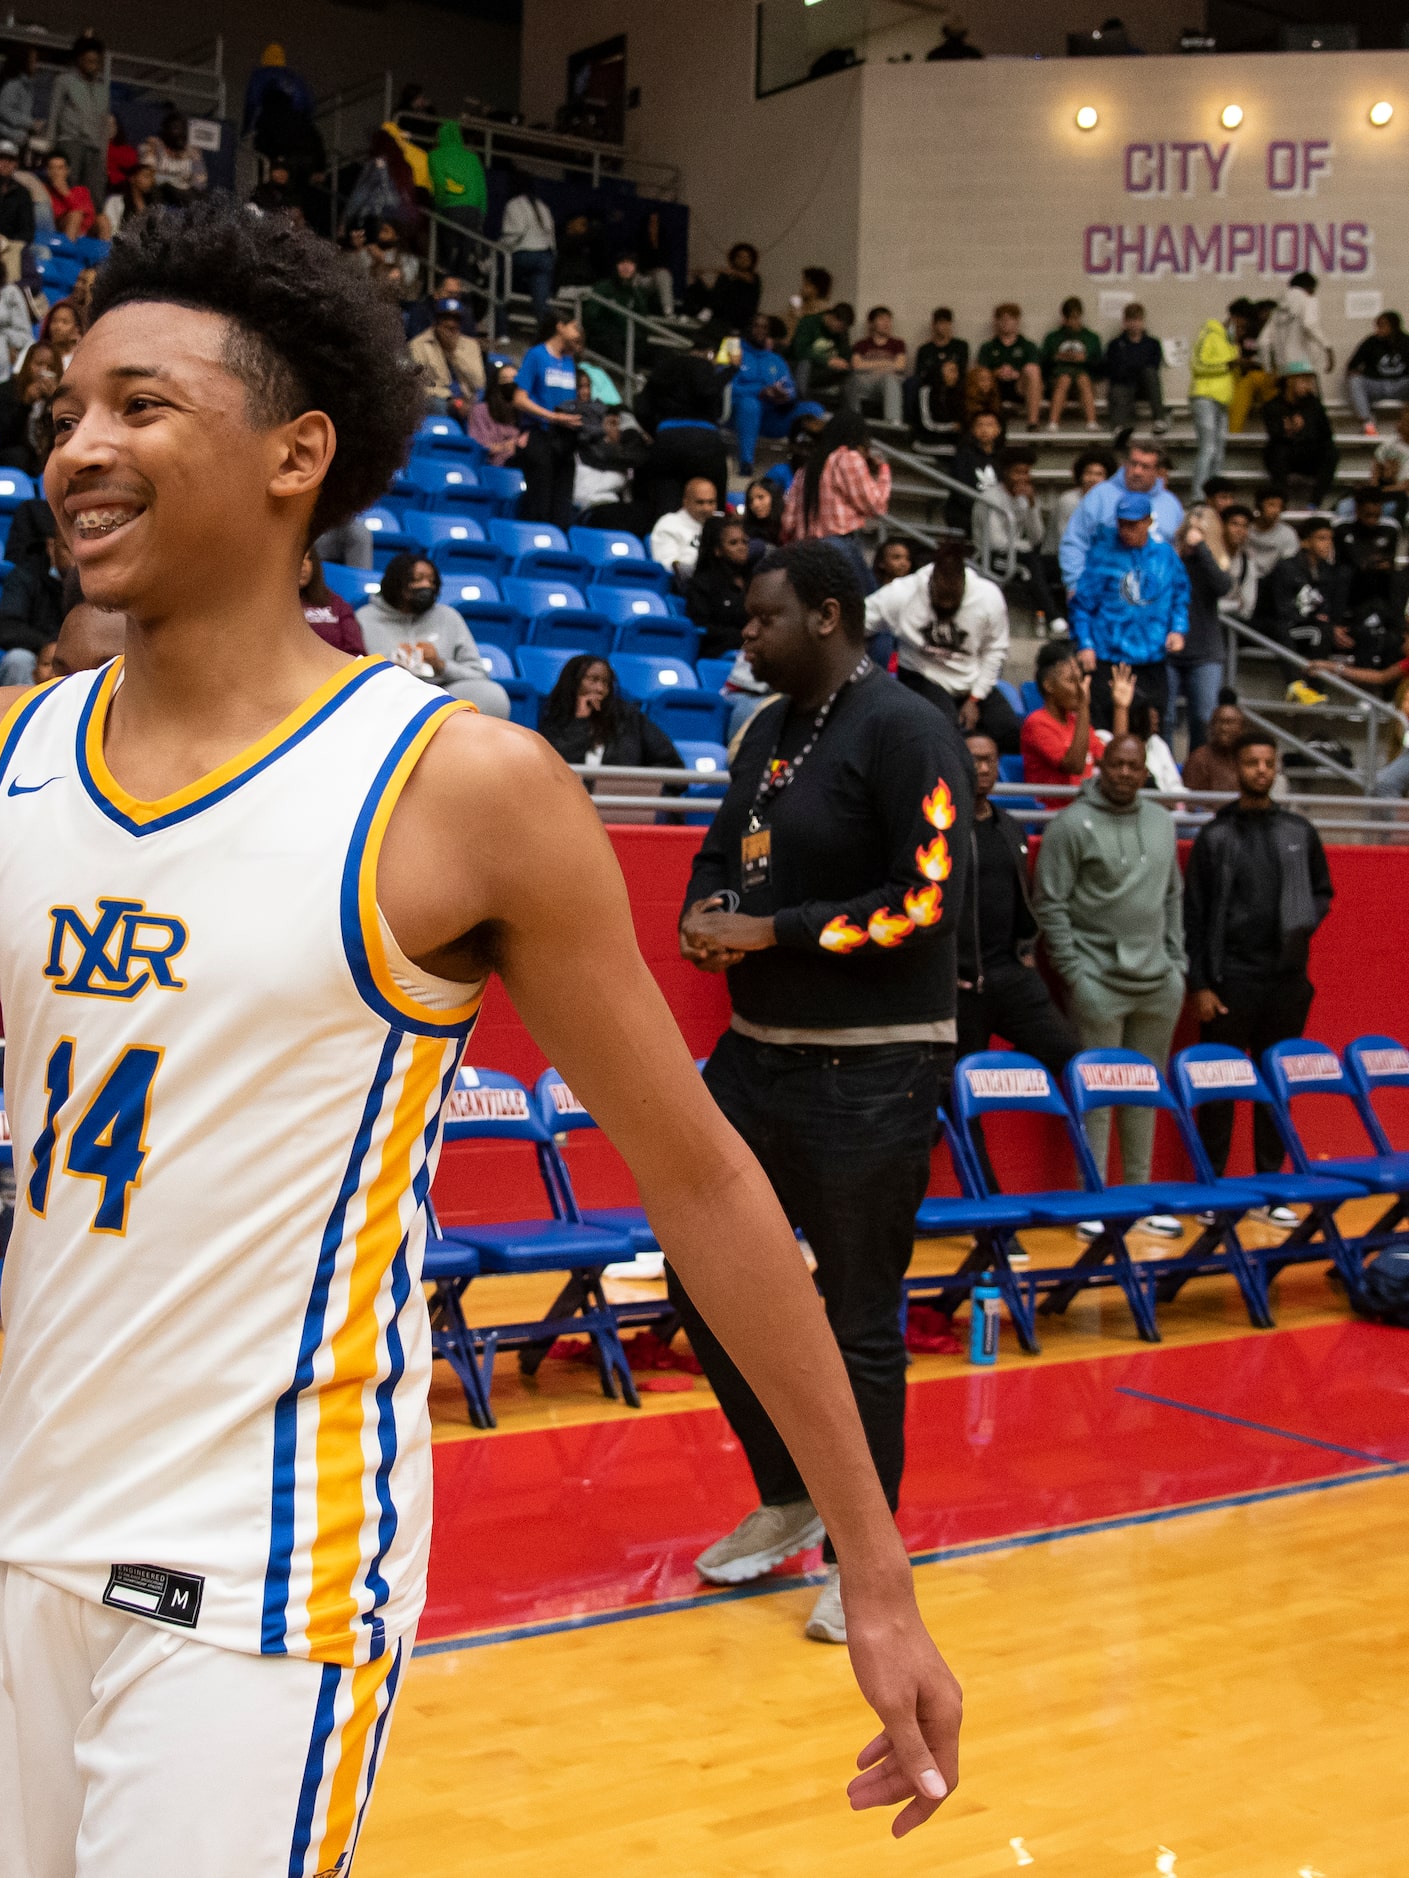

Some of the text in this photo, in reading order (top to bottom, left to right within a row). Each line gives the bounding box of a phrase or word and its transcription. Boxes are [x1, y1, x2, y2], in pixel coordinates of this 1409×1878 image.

[1123, 139, 1332, 195] CITY OF
[1082, 221, 1371, 276] CHAMPIONS
[26, 1034, 166, 1238] 14
[117, 1565, 165, 1583] ENGINEERED
[170, 1588, 189, 1610] M
